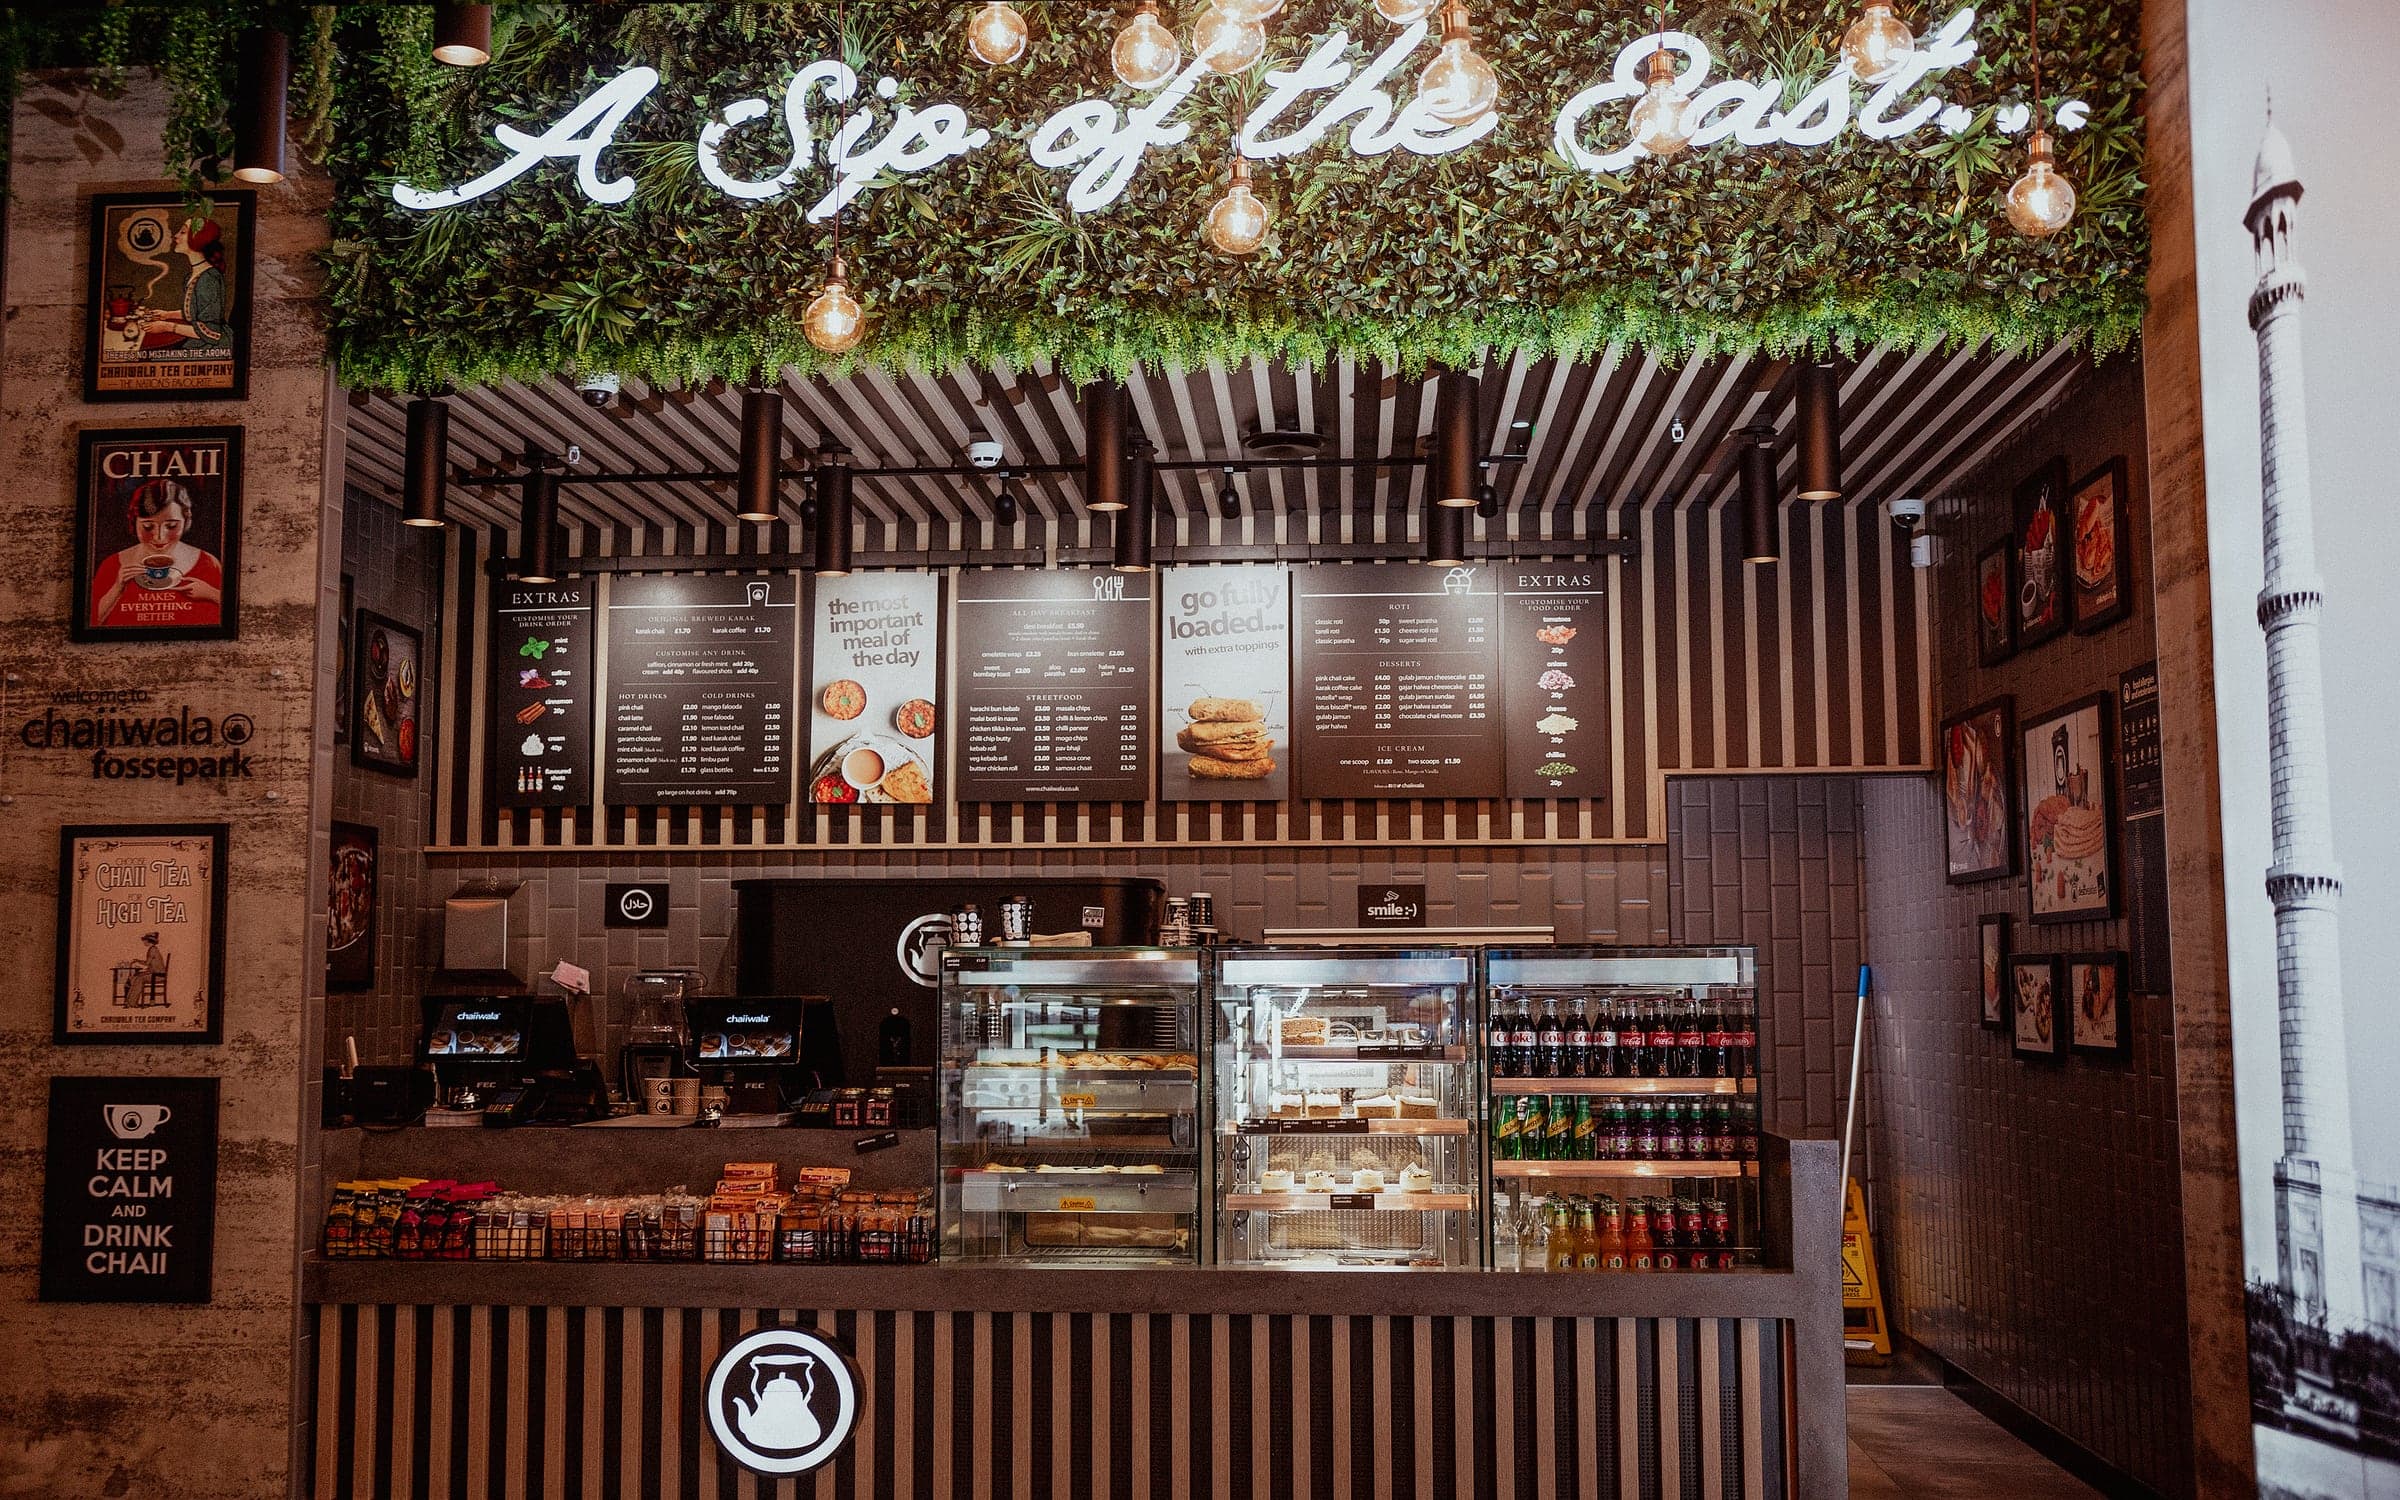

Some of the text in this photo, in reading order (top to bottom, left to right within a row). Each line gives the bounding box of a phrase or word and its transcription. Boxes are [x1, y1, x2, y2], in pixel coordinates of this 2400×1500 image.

[393, 67, 658, 209] A
[697, 60, 988, 225] Sip
[1029, 38, 1224, 213] of
[1240, 19, 1499, 159] the
[137, 350, 147, 360] NO
[148, 349, 188, 360] MISTAKING
[190, 349, 203, 358] THE
[205, 348, 232, 358] AROMA
[101, 364, 232, 378] CHAIIWALA TEA COMPANY
[102, 450, 222, 478] CHAII
[1518, 575, 1591, 587] EXTRAS
[138, 593, 176, 601] MAKES
[513, 592, 580, 604] EXTRAS
[828, 595, 909, 615] the most
[1181, 579, 1280, 616] go fully
[121, 602, 192, 612] EVERYTHING
[137, 613, 175, 621] BETTER
[830, 612, 923, 636] important
[1169, 608, 1285, 639] loaded...
[843, 628, 910, 650] meal of
[1185, 640, 1279, 656] with extra toppings
[853, 648, 920, 667] the day
[50, 688, 148, 701] welcome to
[22, 705, 213, 748] chaiiwala
[92, 748, 252, 785] fossepark
[96, 859, 192, 891] CHAII TEA
[96, 896, 187, 928] HIGH TEA
[625, 899, 648, 910] حلال
[1367, 903, 1403, 916] smile
[457, 1012, 500, 1021] chaiiwala
[726, 1014, 770, 1023] chaiiwala
[477, 1081, 497, 1089] FEC
[97, 1148, 167, 1170] KEEP
[88, 1176, 172, 1198] CALM
[112, 1205, 146, 1217] AND
[84, 1225, 173, 1247] DRINK
[86, 1252, 166, 1274] CHAII
